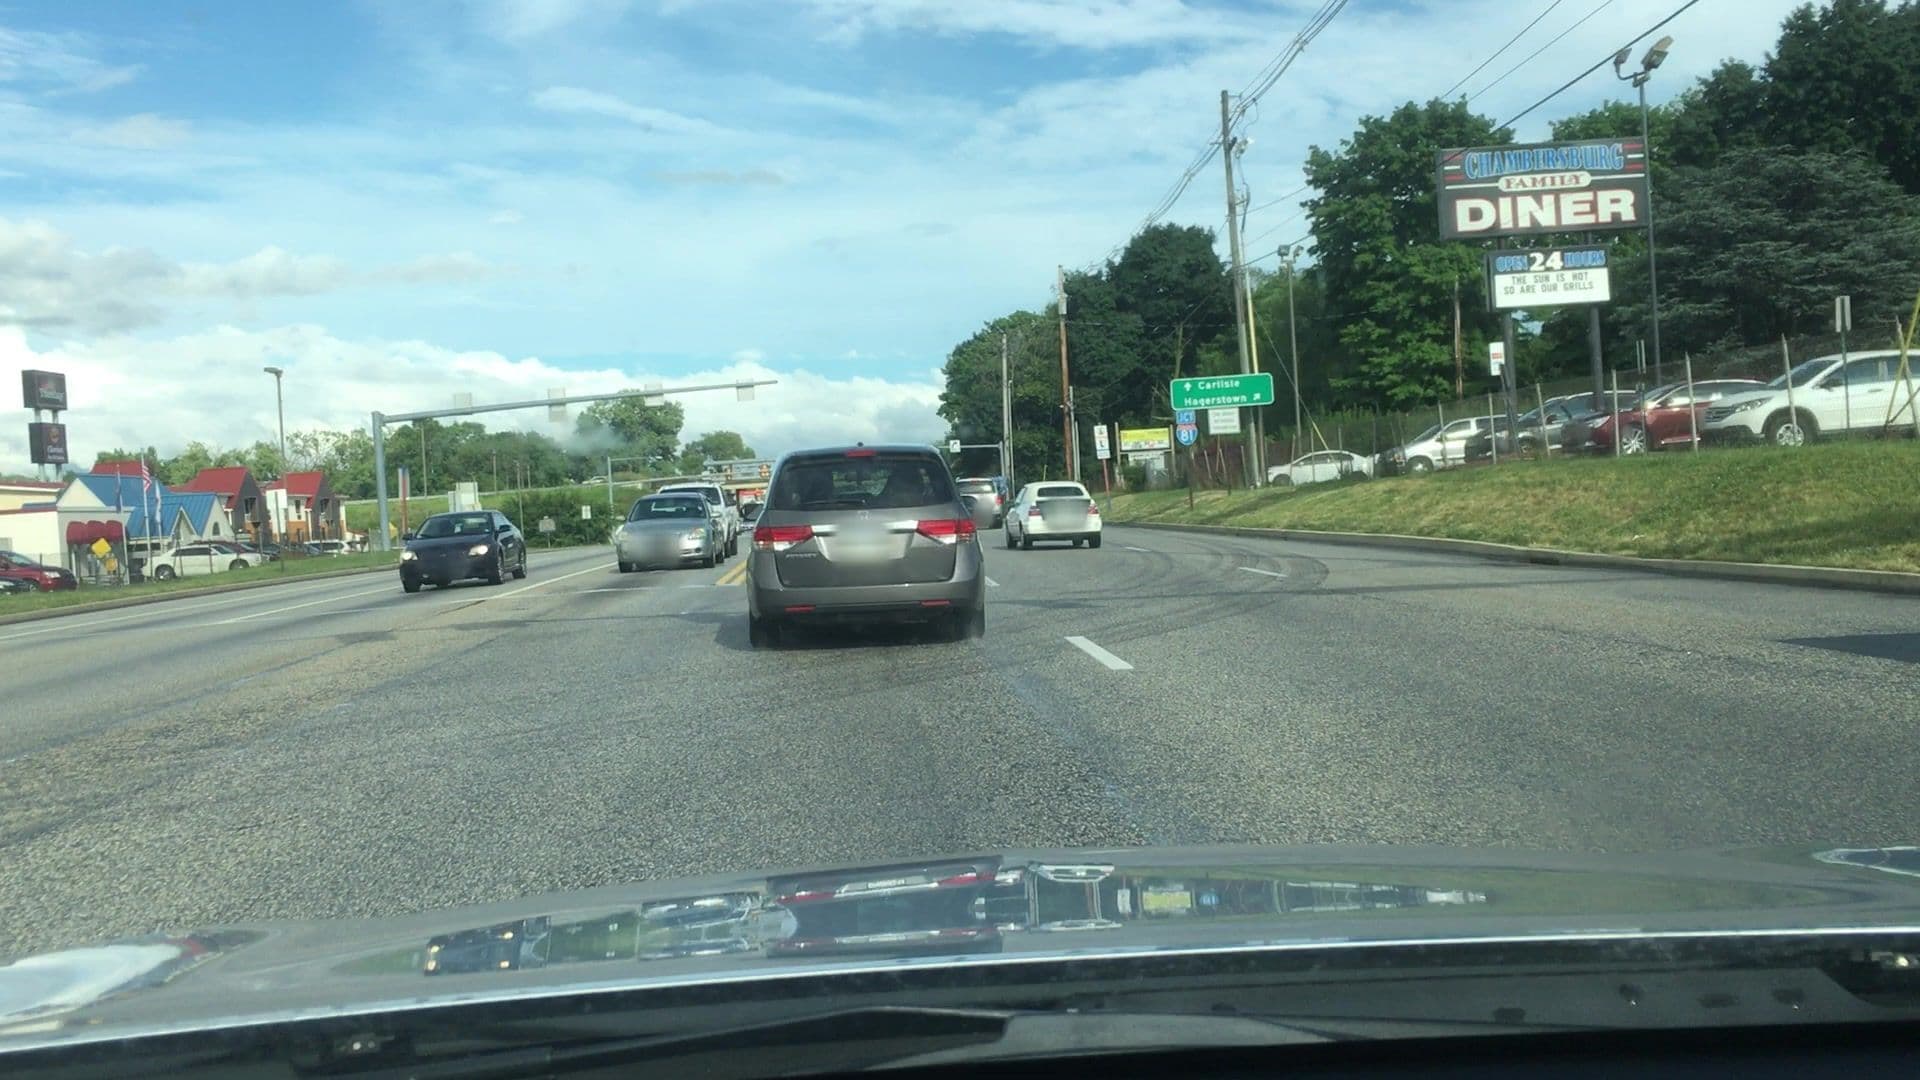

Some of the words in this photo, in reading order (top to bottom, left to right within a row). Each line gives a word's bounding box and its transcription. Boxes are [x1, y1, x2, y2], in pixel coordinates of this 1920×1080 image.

[1464, 143, 1624, 179] CHAMBERSBURG
[1505, 174, 1585, 189] FAMILY
[1456, 189, 1636, 232] DINER
[1496, 255, 1528, 272] OPEN
[1529, 251, 1563, 271] 24
[1564, 250, 1606, 267] HOURS
[1512, 275, 1527, 285] THE
[1533, 274, 1550, 284] SUN
[1556, 273, 1566, 282] IS
[1572, 272, 1588, 281] HOT
[1503, 286, 1515, 295] SO
[1520, 285, 1536, 294] ARE
[1541, 283, 1558, 293] OUR
[1563, 281, 1594, 291] GRILLS
[1198, 380, 1240, 390] Carlisle
[1184, 395, 1247, 407] Hagerstown
[1181, 429, 1193, 442] 81
